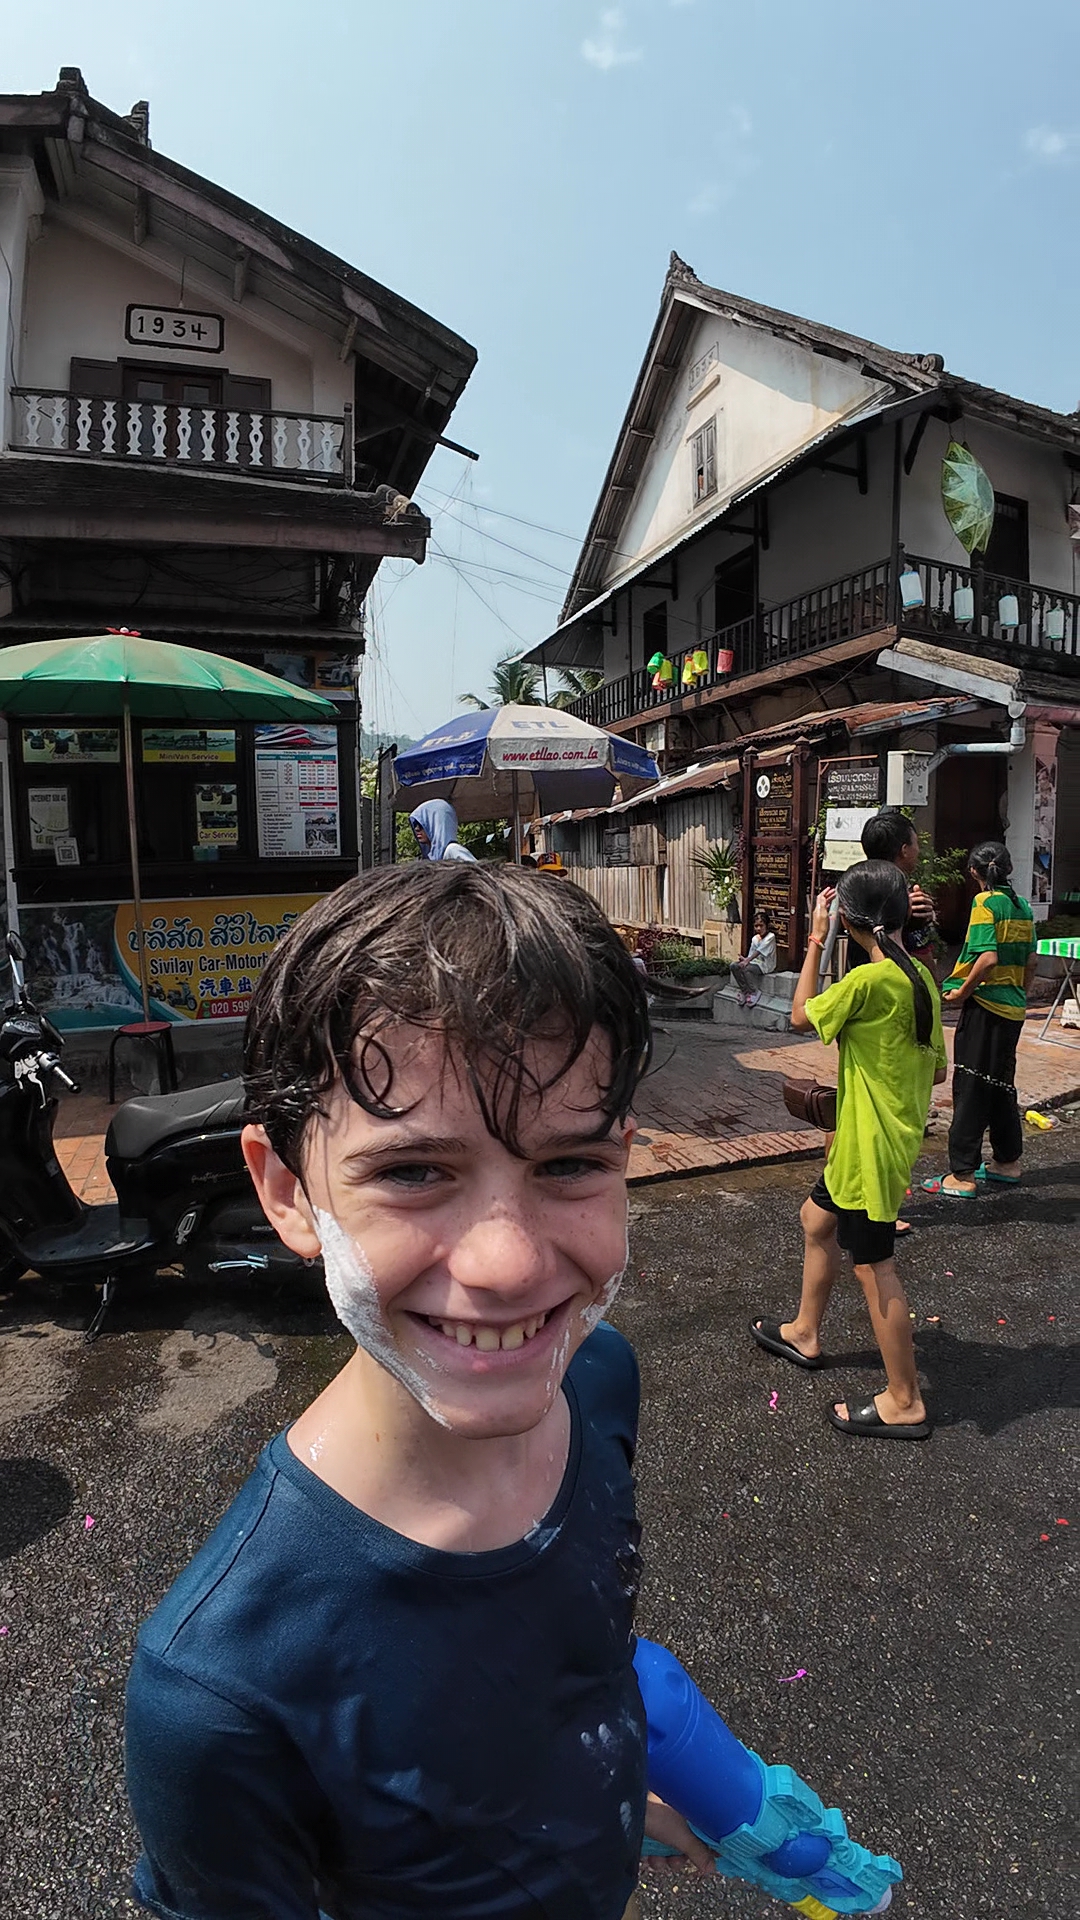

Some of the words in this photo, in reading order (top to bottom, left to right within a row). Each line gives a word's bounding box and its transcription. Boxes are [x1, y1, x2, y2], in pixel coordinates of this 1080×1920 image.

[137, 315, 208, 340] 1934
[511, 720, 569, 729] ETL
[159, 752, 190, 760] MiniVan
[192, 752, 219, 761] Service
[502, 745, 599, 762] www.etllao.com.la
[199, 830, 214, 839] Car
[216, 830, 238, 840] Service
[151, 957, 194, 976] Sivilay
[211, 1002, 229, 1014] 020
